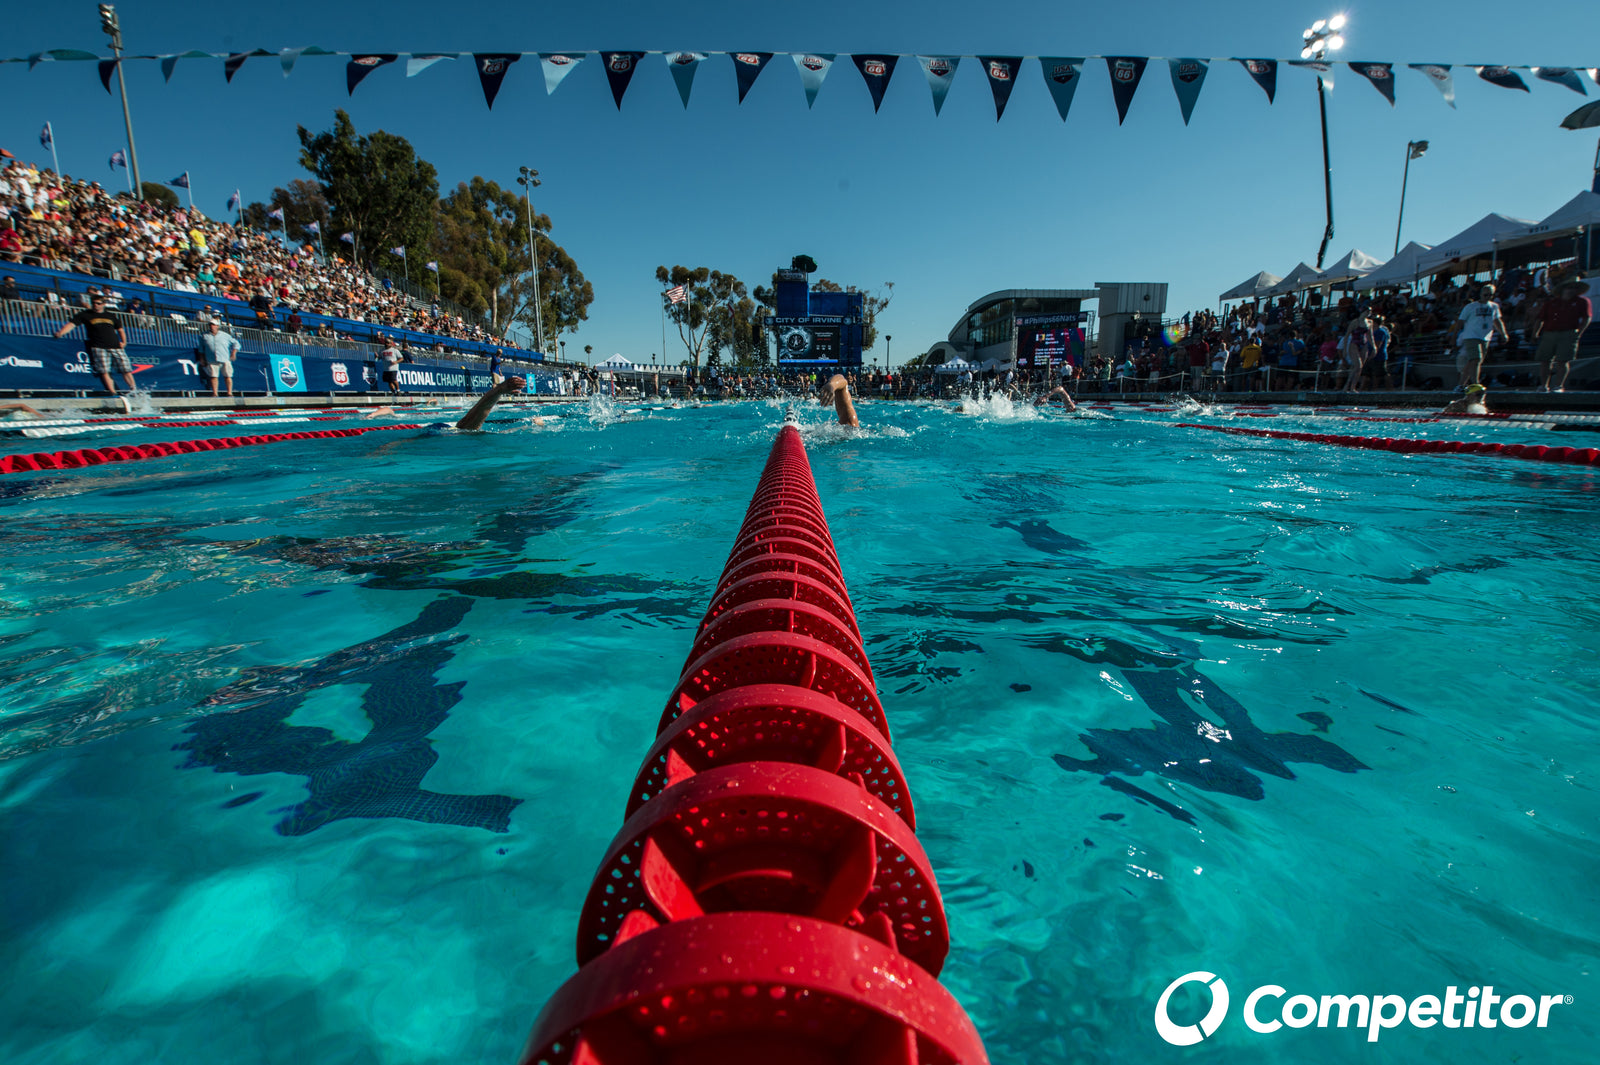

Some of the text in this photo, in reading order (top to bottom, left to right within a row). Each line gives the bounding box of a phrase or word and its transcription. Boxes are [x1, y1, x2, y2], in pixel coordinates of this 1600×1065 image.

[614, 61, 627, 69] 66
[868, 65, 882, 73] 66
[1053, 64, 1071, 73] USA
[993, 69, 1006, 77] 66
[1117, 69, 1131, 79] 66
[128, 354, 160, 366] peedo
[64, 362, 91, 374] OME
[177, 359, 199, 376] TY
[336, 372, 346, 382] 66
[397, 370, 436, 386] ATIONAL
